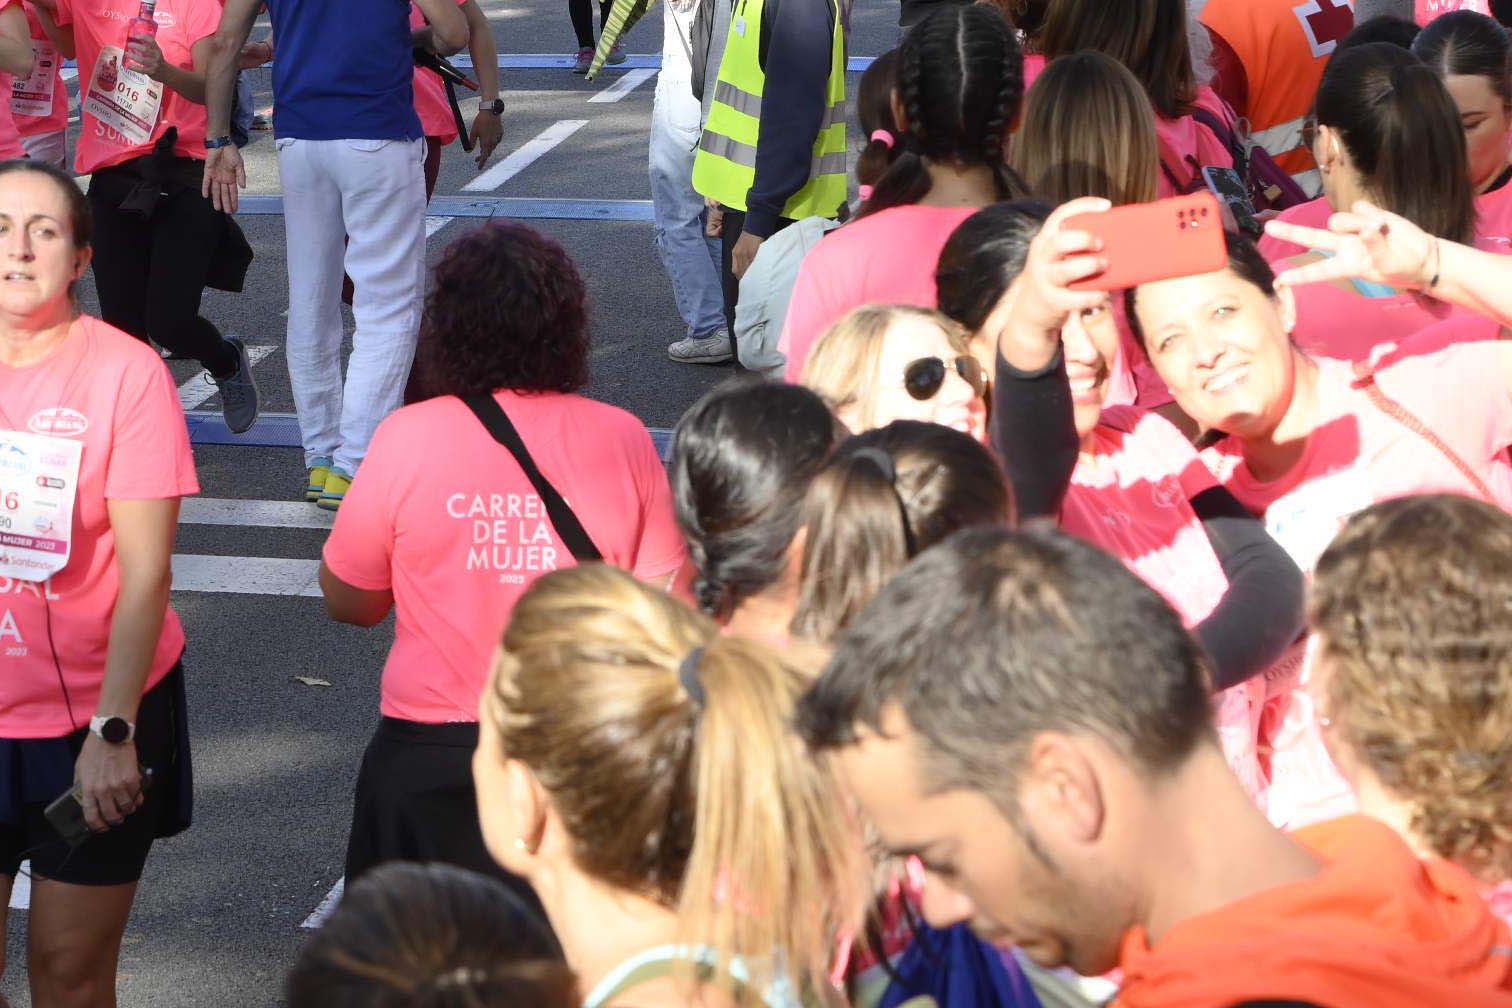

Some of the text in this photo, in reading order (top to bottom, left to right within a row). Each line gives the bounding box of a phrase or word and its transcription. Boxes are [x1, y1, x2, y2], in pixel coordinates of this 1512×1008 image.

[117, 82, 140, 102] 016
[446, 492, 547, 519] CARRE
[2, 533, 33, 547] MUJER
[473, 520, 553, 544] DE LA
[466, 545, 558, 571] MUJER
